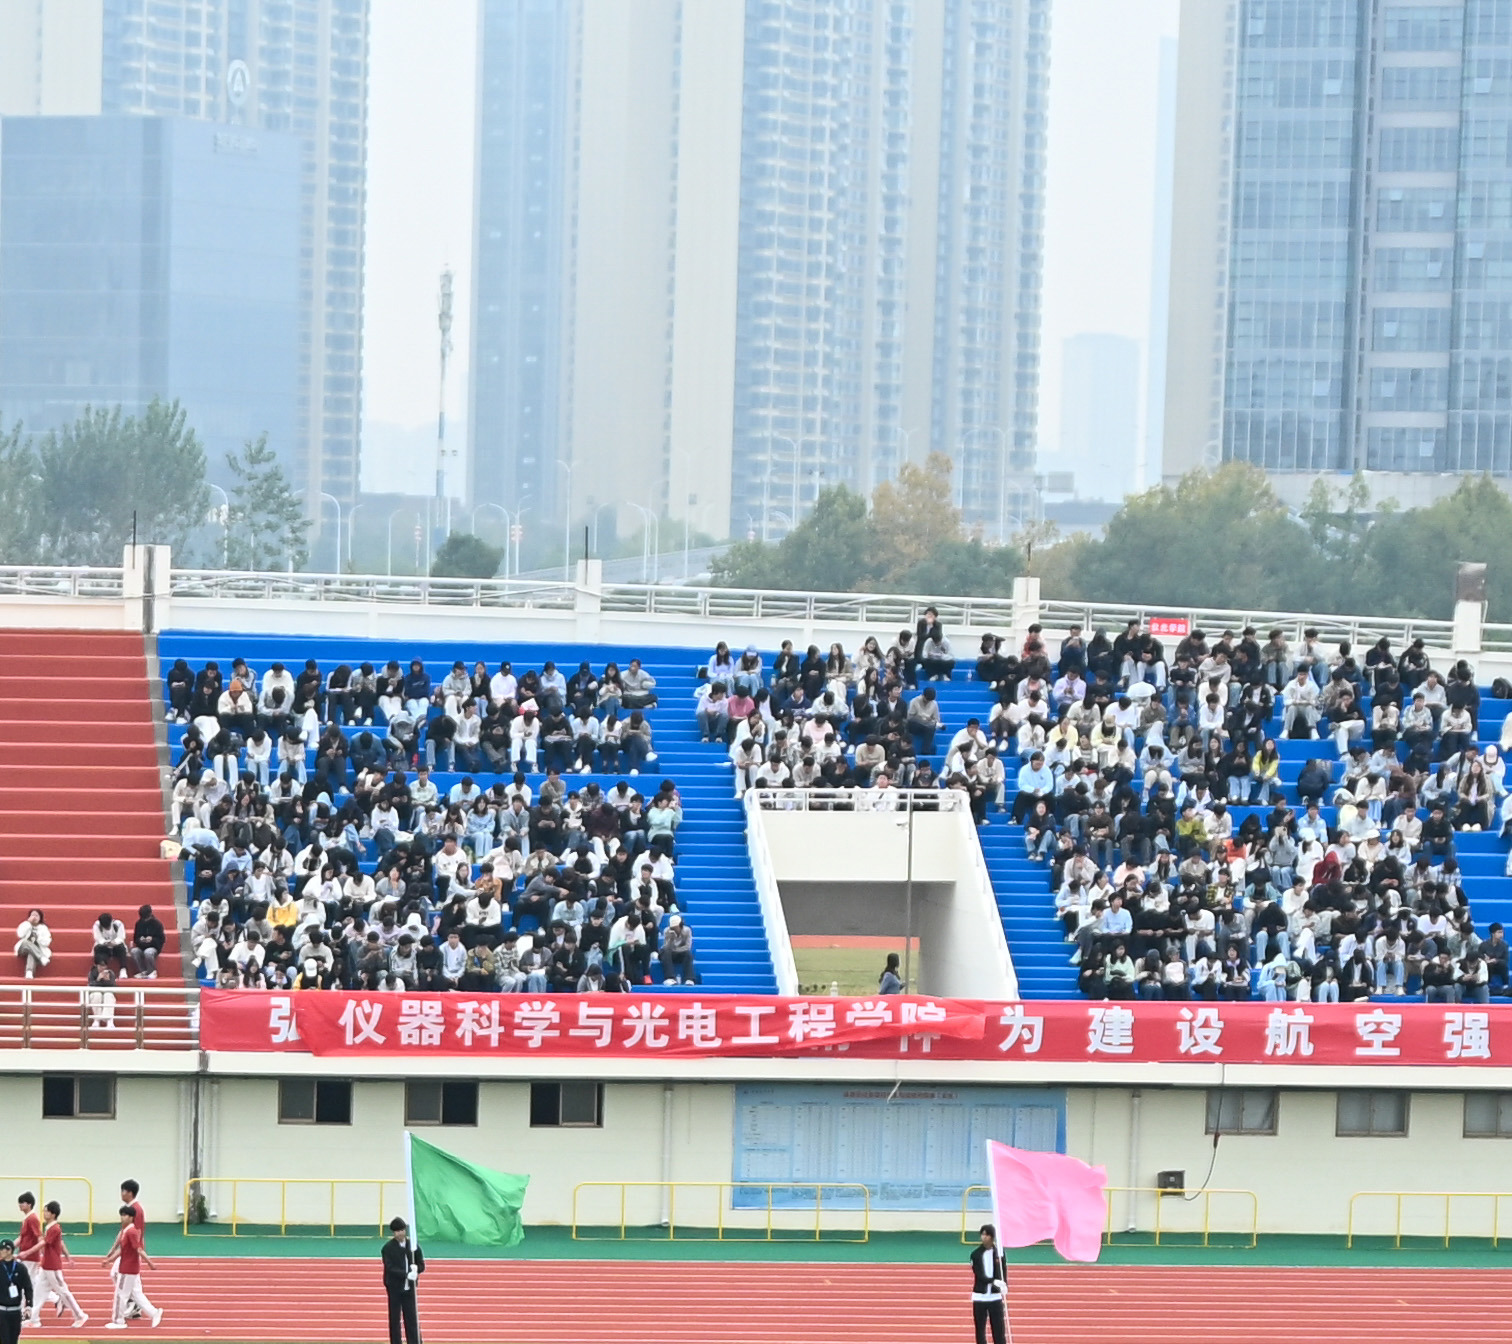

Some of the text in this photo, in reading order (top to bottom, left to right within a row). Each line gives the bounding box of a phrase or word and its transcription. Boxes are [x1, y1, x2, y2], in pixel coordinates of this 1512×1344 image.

[341, 1000, 947, 1048] 仪器科学与光电工程学院
